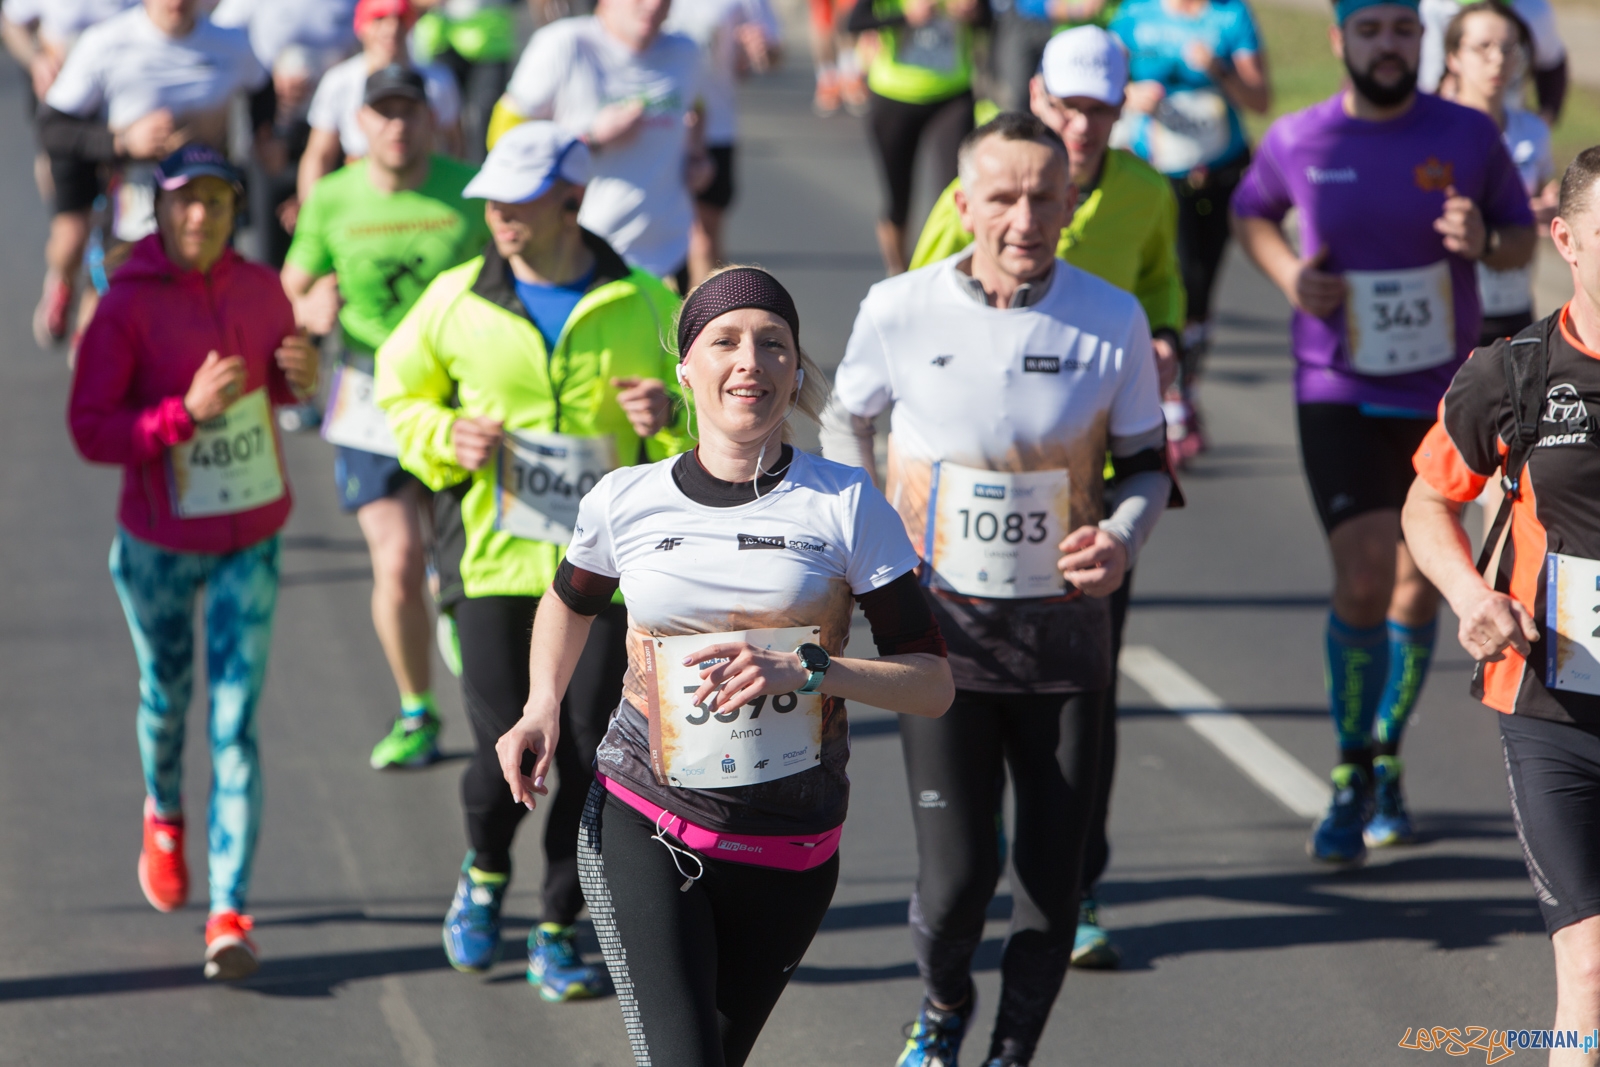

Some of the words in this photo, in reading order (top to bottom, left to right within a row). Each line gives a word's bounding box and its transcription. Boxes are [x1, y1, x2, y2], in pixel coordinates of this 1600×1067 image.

[1371, 298, 1432, 332] 343
[512, 466, 607, 498] 1040
[958, 508, 1048, 544] 1083
[730, 727, 763, 740] Anna
